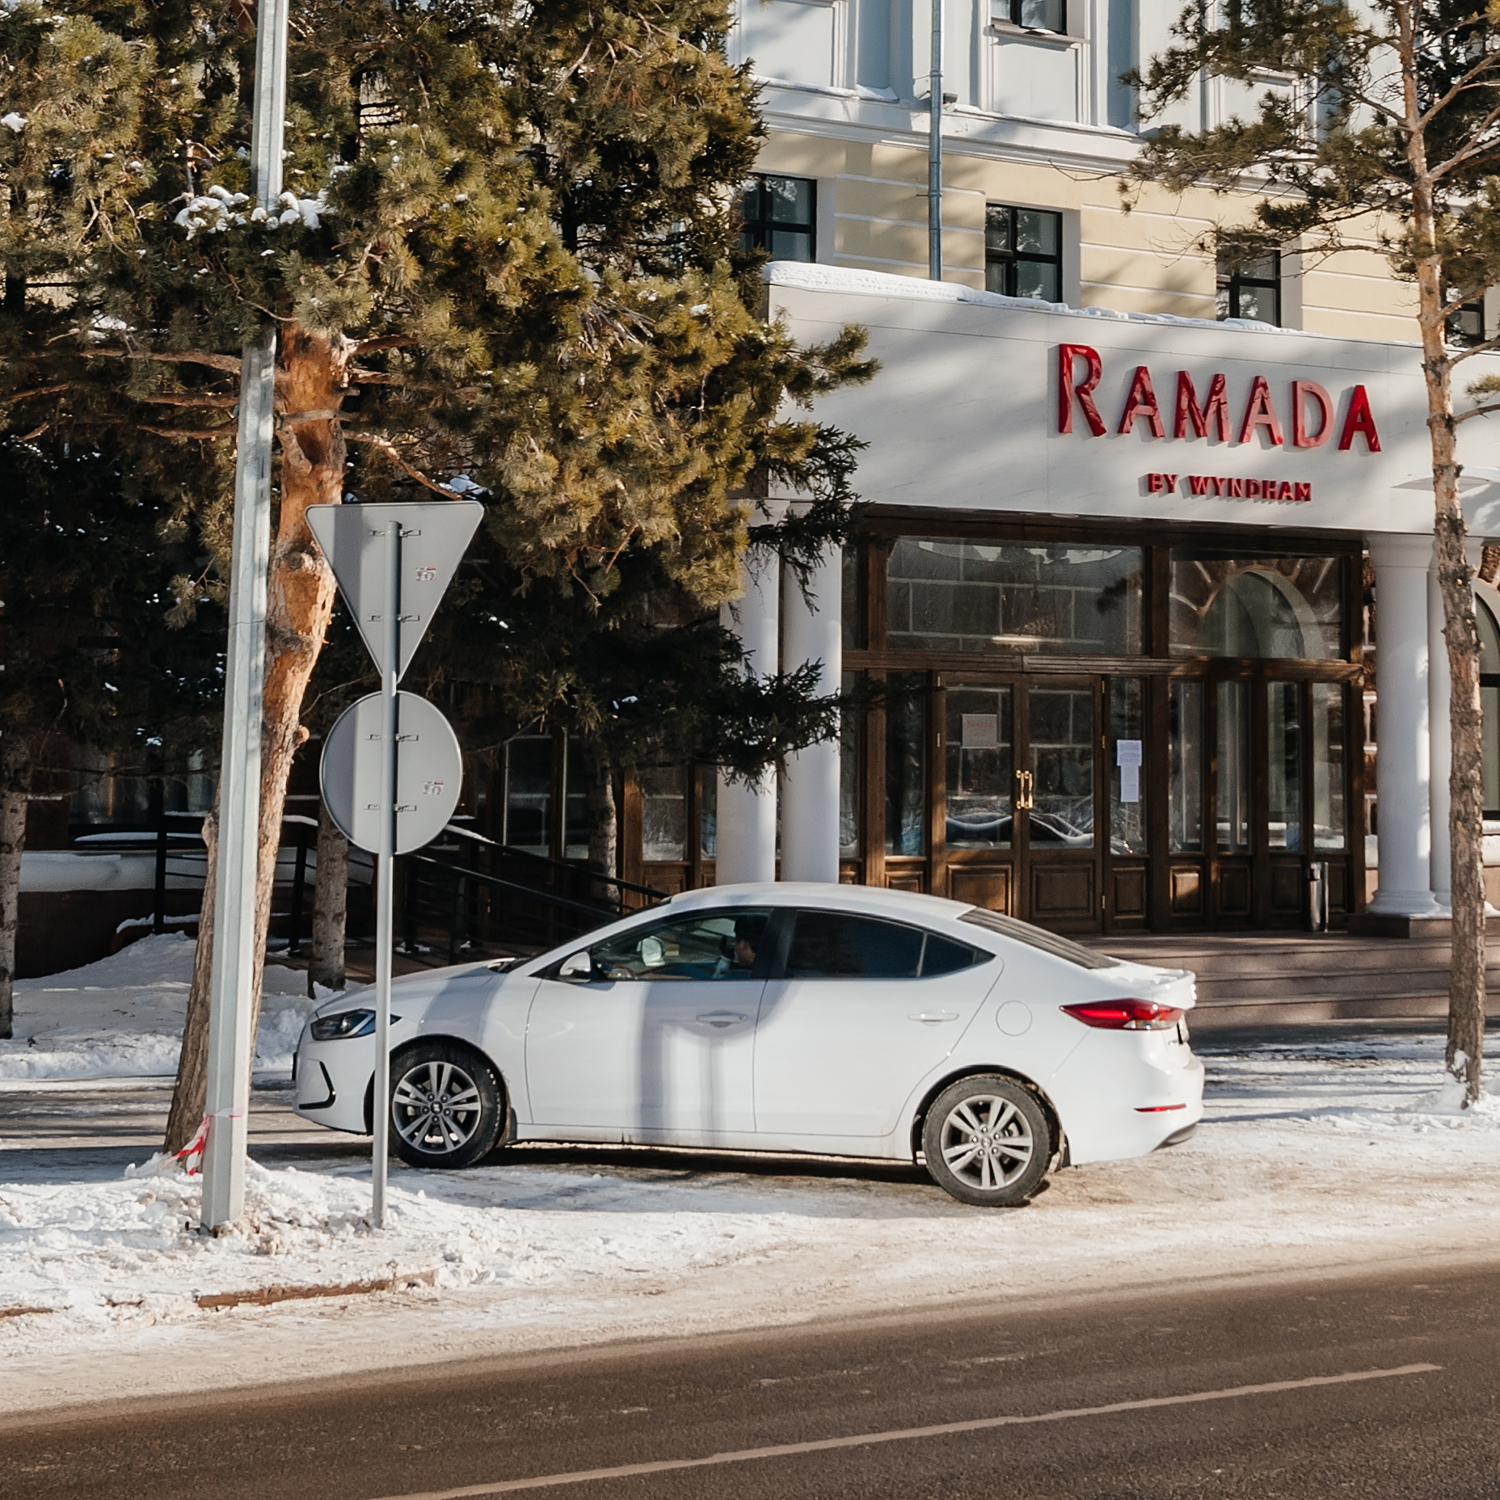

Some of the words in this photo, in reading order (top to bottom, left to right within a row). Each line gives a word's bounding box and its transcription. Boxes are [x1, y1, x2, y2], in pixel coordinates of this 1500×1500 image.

[1057, 343, 1382, 452] RAMADA
[1147, 472, 1179, 494] BY
[1188, 474, 1312, 502] WYNDHAM
